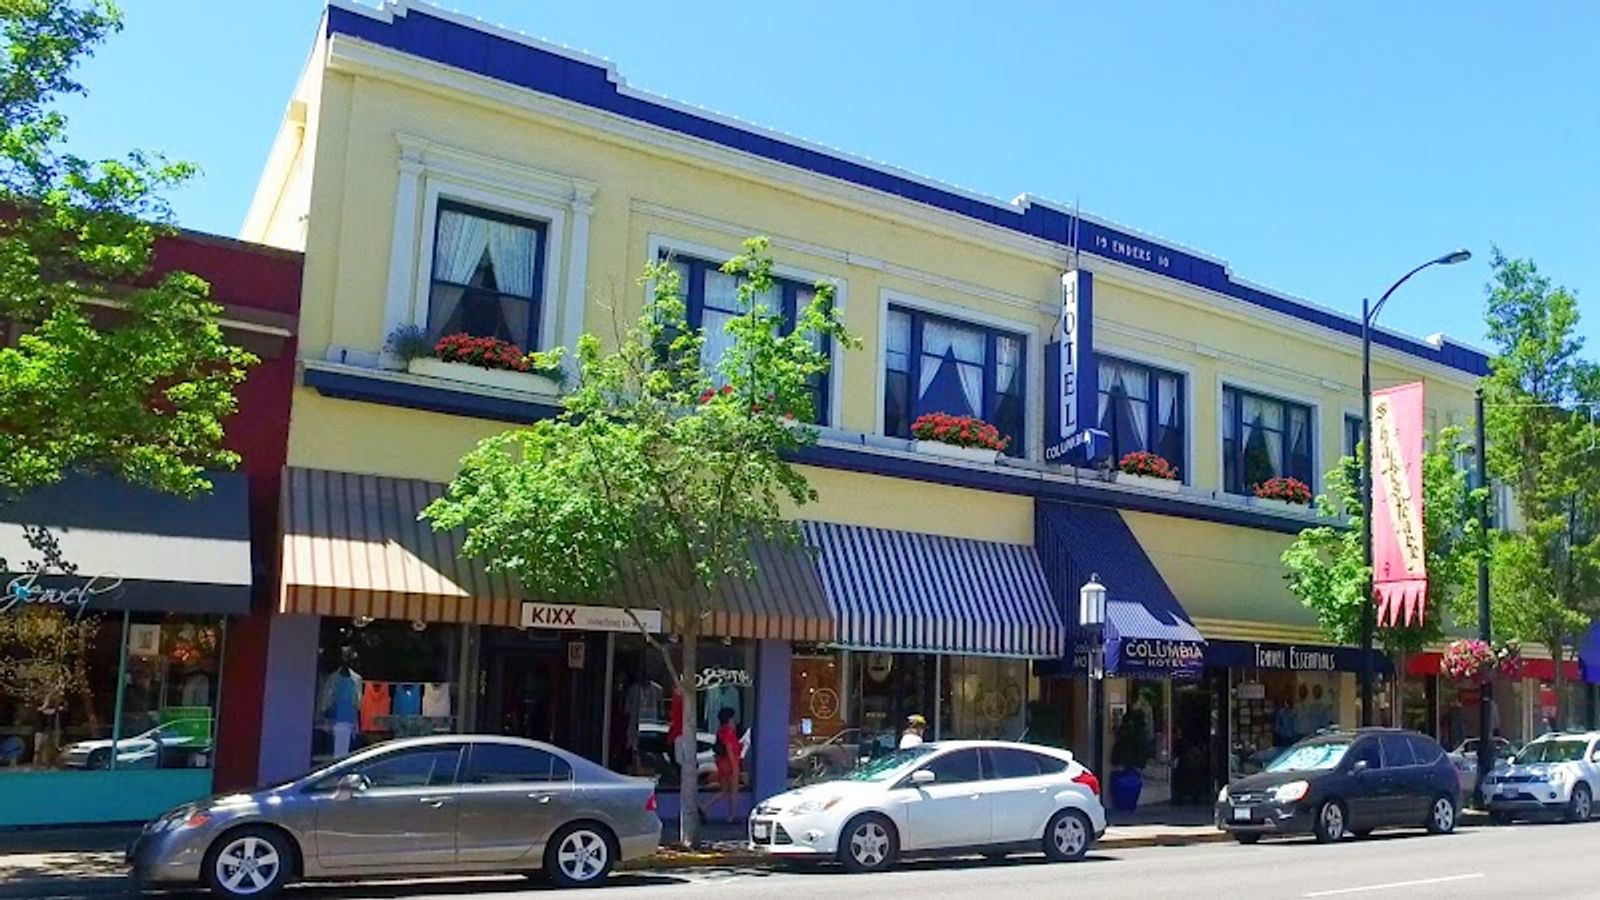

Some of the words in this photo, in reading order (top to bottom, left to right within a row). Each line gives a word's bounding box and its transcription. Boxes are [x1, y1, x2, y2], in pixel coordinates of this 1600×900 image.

[1096, 235, 1107, 248] 19
[1112, 240, 1151, 261] ENDERS
[1064, 279, 1076, 427] HOTEL
[531, 607, 576, 625] KIXX
[1126, 640, 1203, 658] COLUMBIA
[1148, 658, 1188, 667] HOTEL
